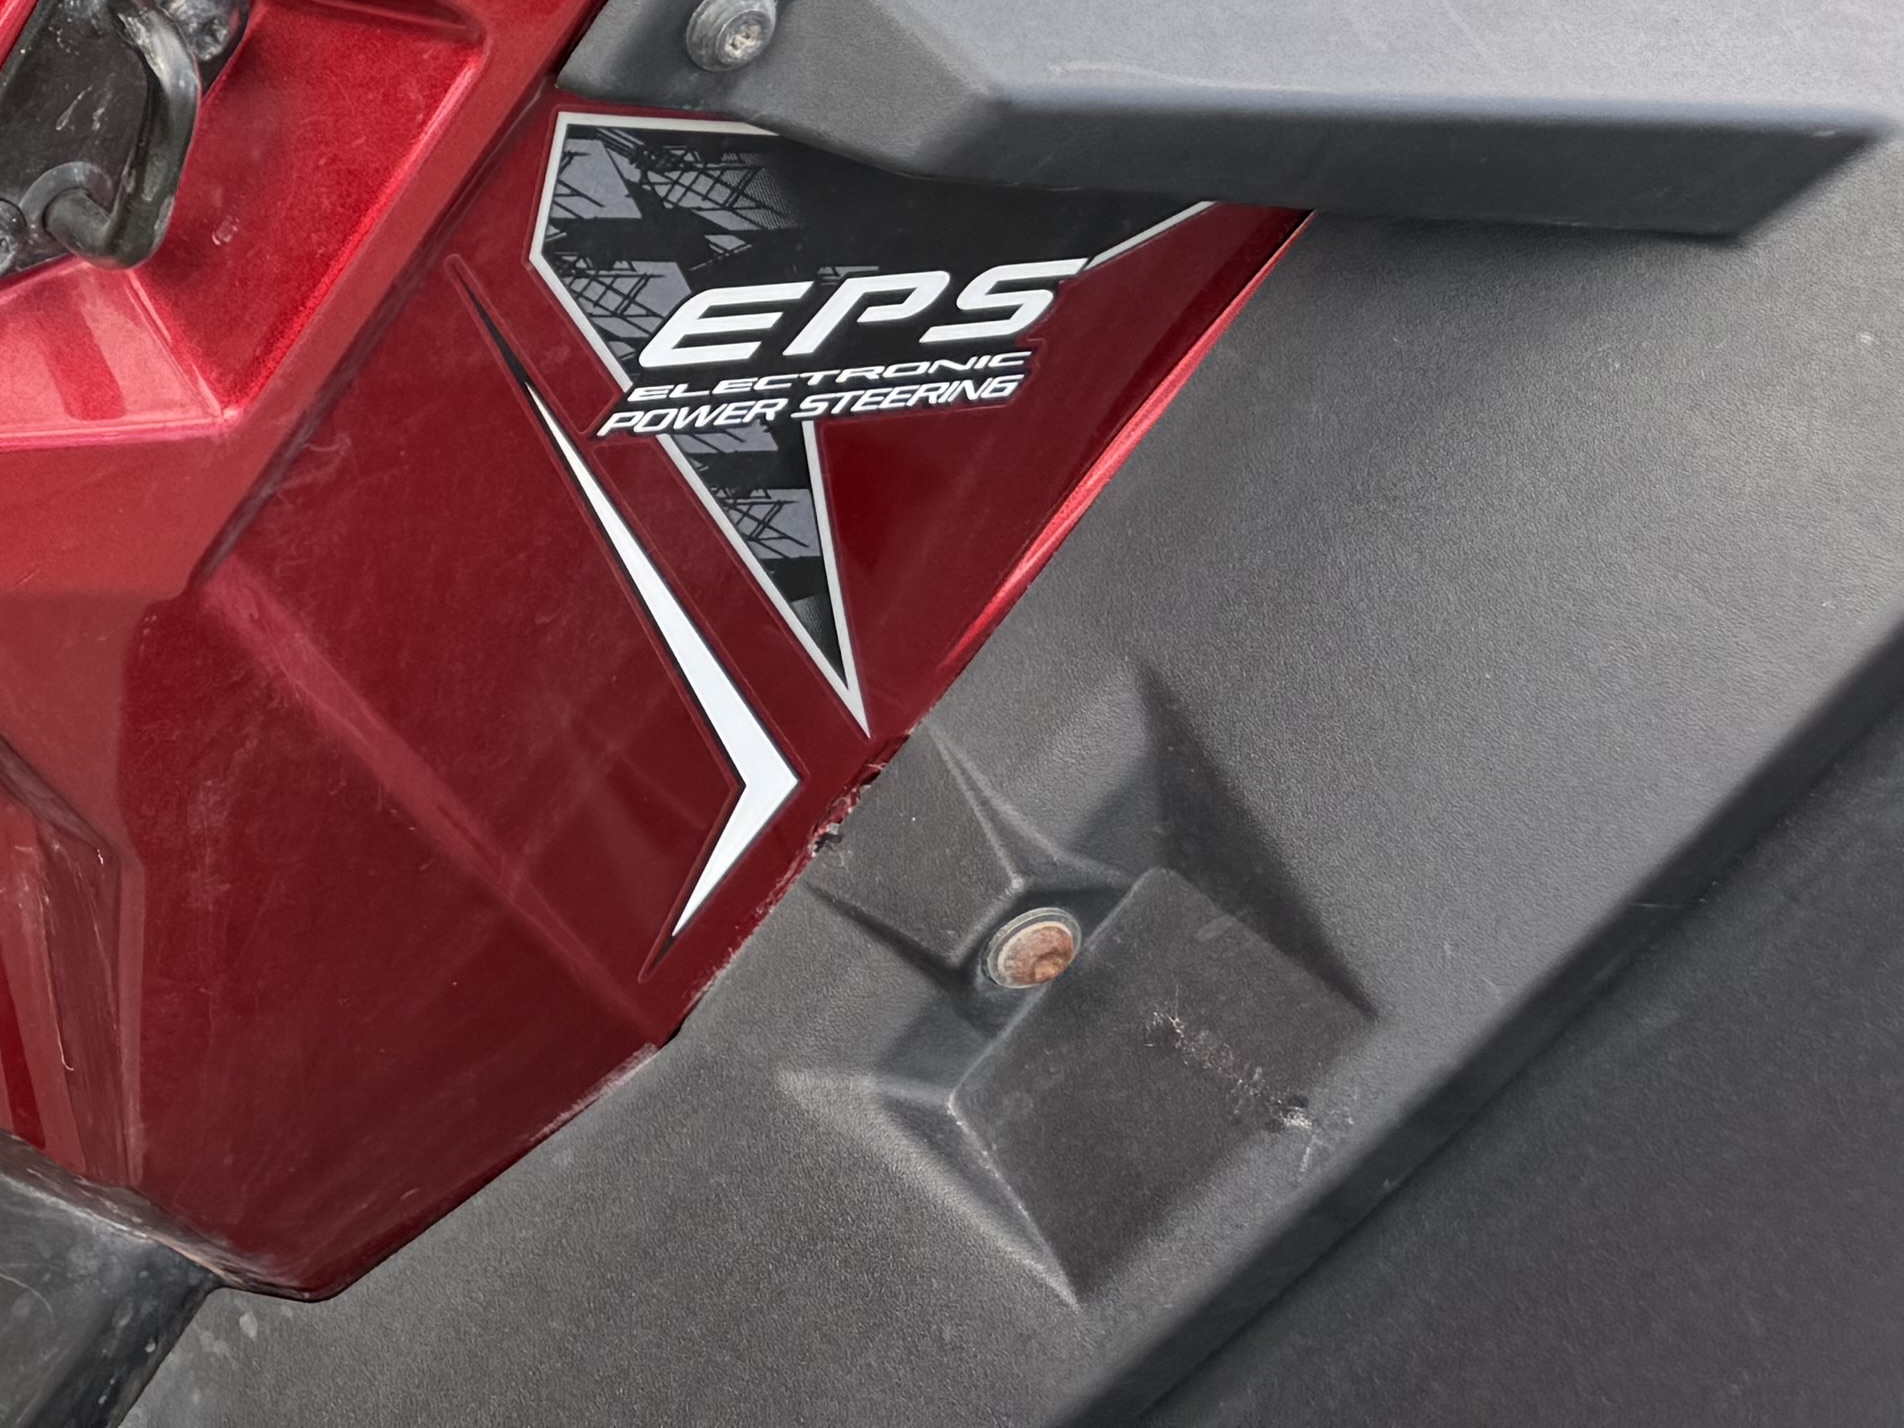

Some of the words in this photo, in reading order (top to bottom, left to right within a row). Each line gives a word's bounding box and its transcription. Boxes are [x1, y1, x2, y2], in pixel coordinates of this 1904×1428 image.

[638, 257, 1089, 368] EPS
[596, 398, 788, 437] POWER
[791, 374, 1025, 419] STEERING
[627, 350, 1032, 403] ELECTRONIC
